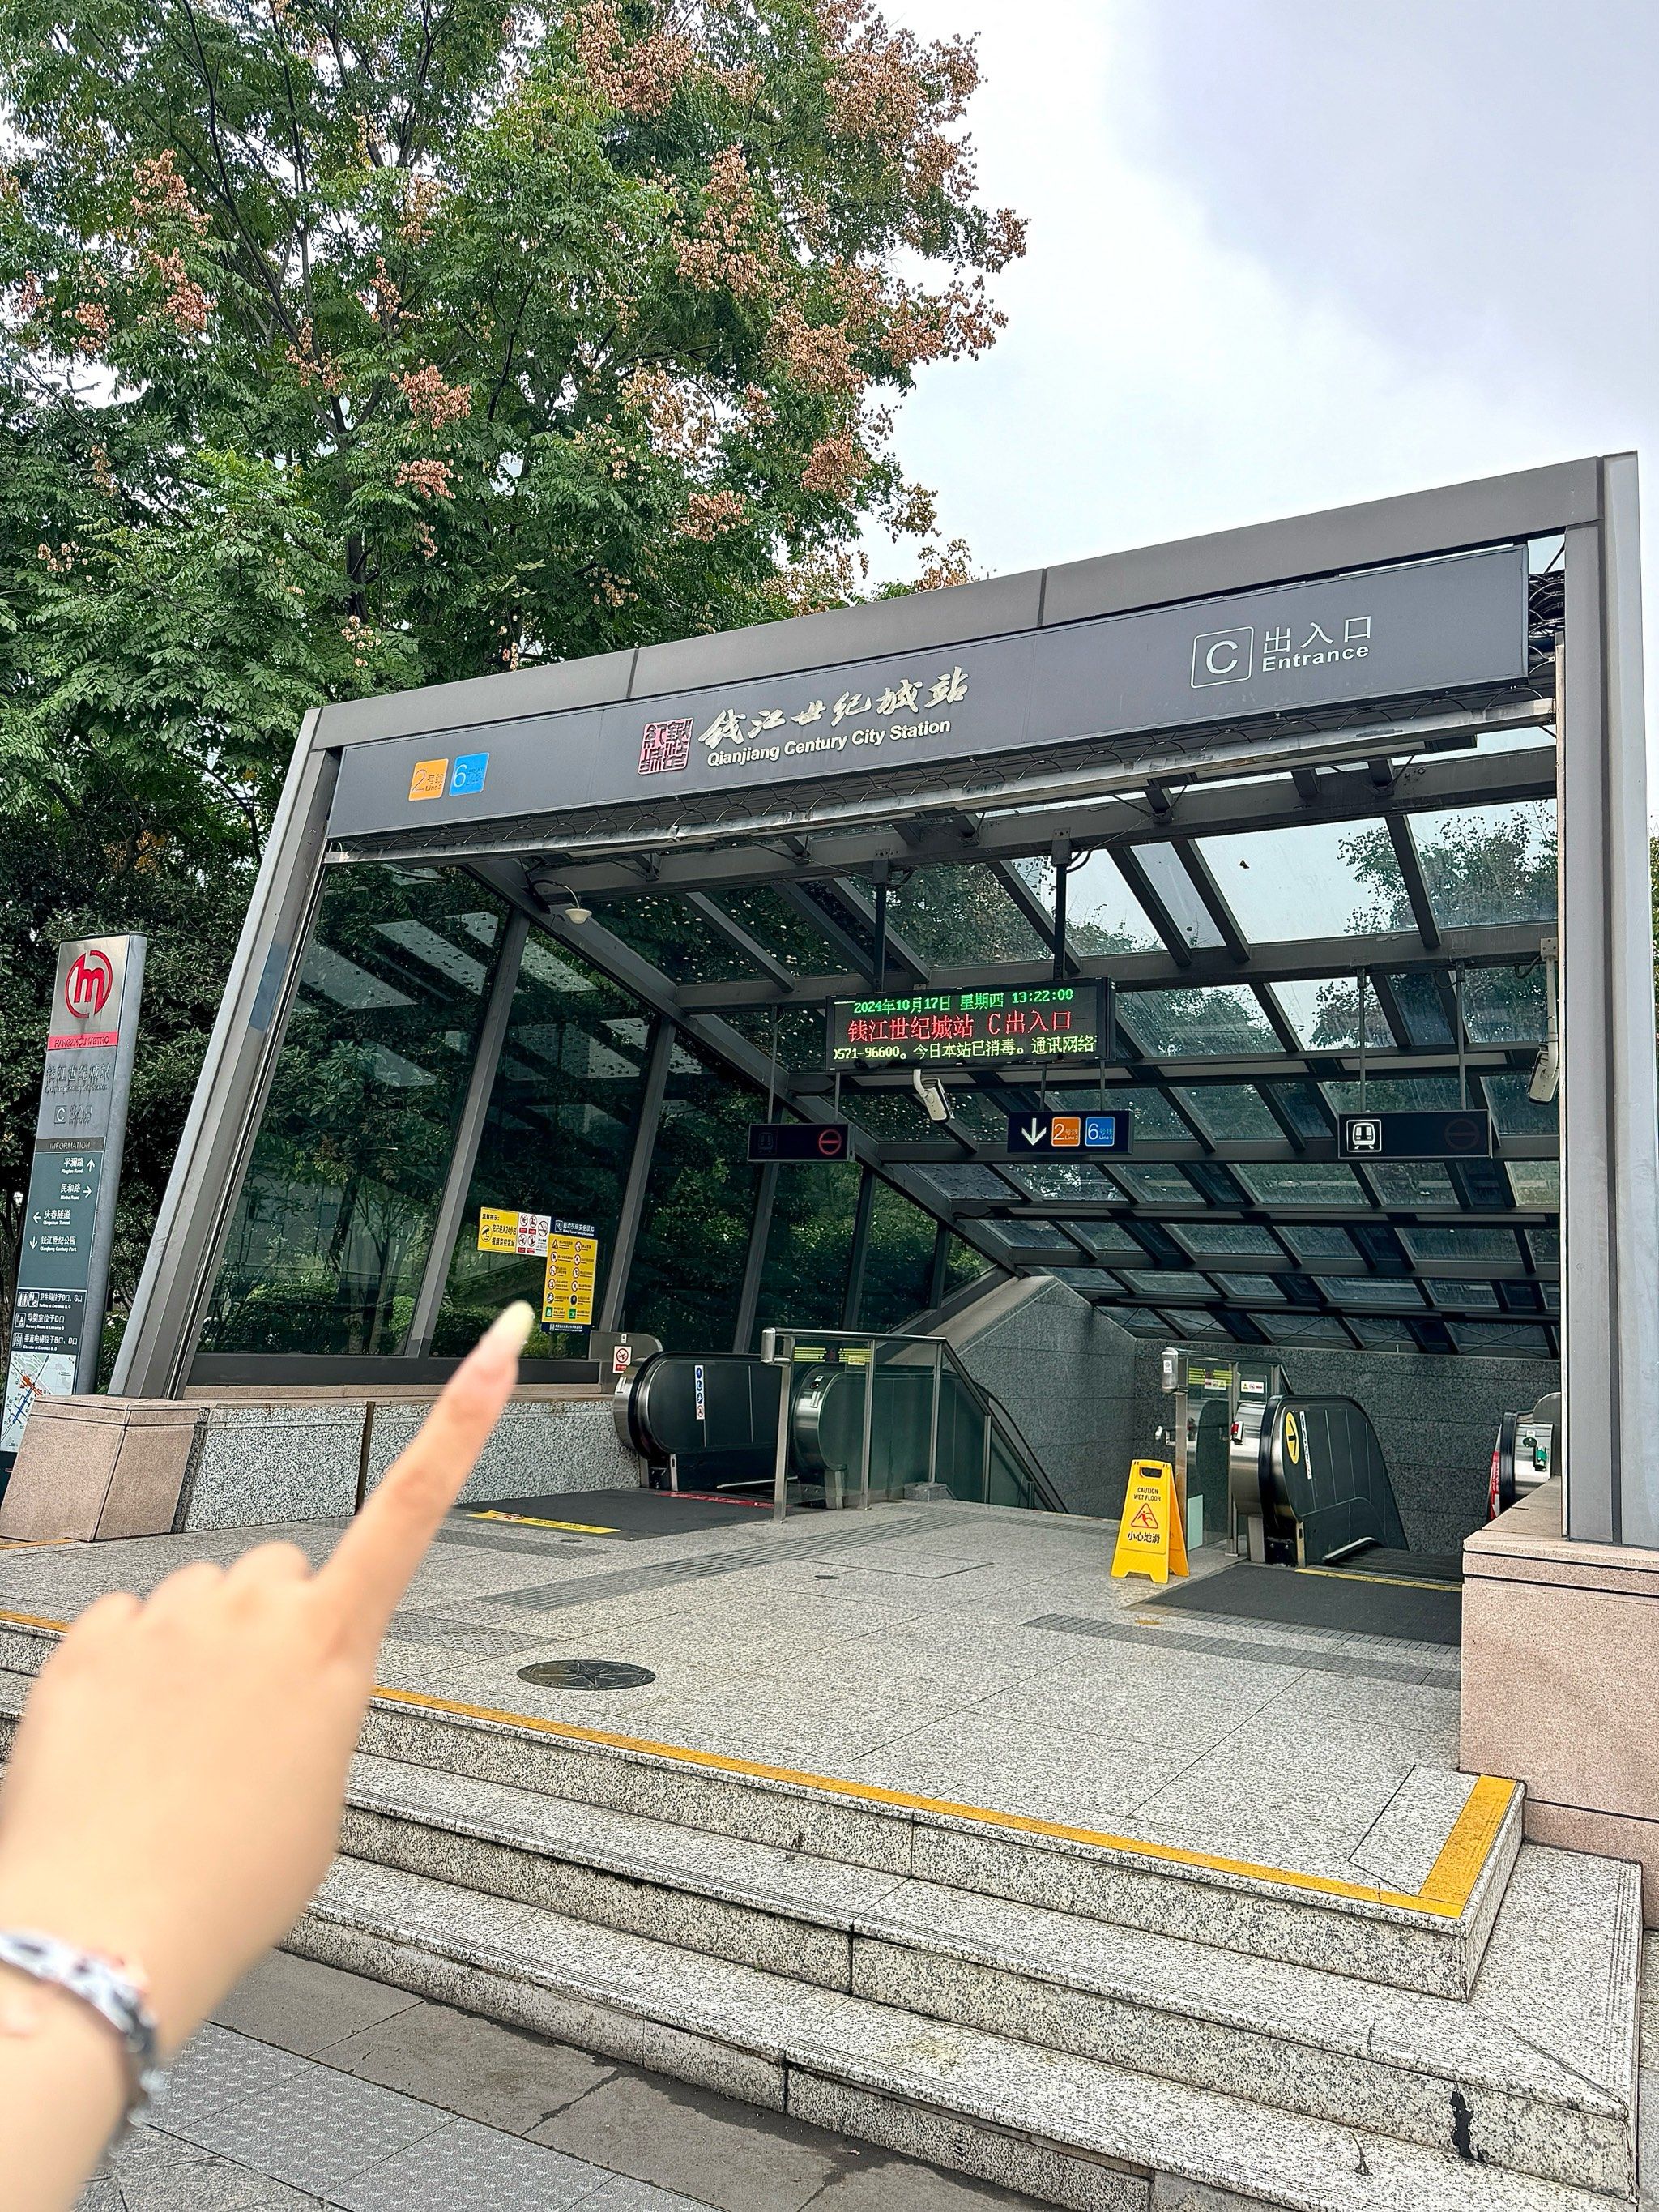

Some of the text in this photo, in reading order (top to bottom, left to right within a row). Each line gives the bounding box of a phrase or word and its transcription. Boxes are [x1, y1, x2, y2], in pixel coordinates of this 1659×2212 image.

[1205, 615, 1371, 675] C 出入口
[1262, 646, 1370, 673] Entrance
[698, 666, 969, 749] 钱江世纪城站
[707, 720, 951, 767] Qianjiang Century City Station
[854, 988, 1074, 1014] 2024年10月17日 星期四 13:22:00
[847, 1013, 975, 1043] 钱江世纪城站
[88, 1036, 109, 1045] METRO
[57, 1108, 66, 1121] C
[49, 1142, 91, 1150] INFORMATION
[60, 1183, 81, 1193] 民和路
[44, 1209, 70, 1219] 庆春隧道
[41, 1236, 76, 1245] 钱江世纪公园
[1128, 1531, 1160, 1544] 小心地滑
